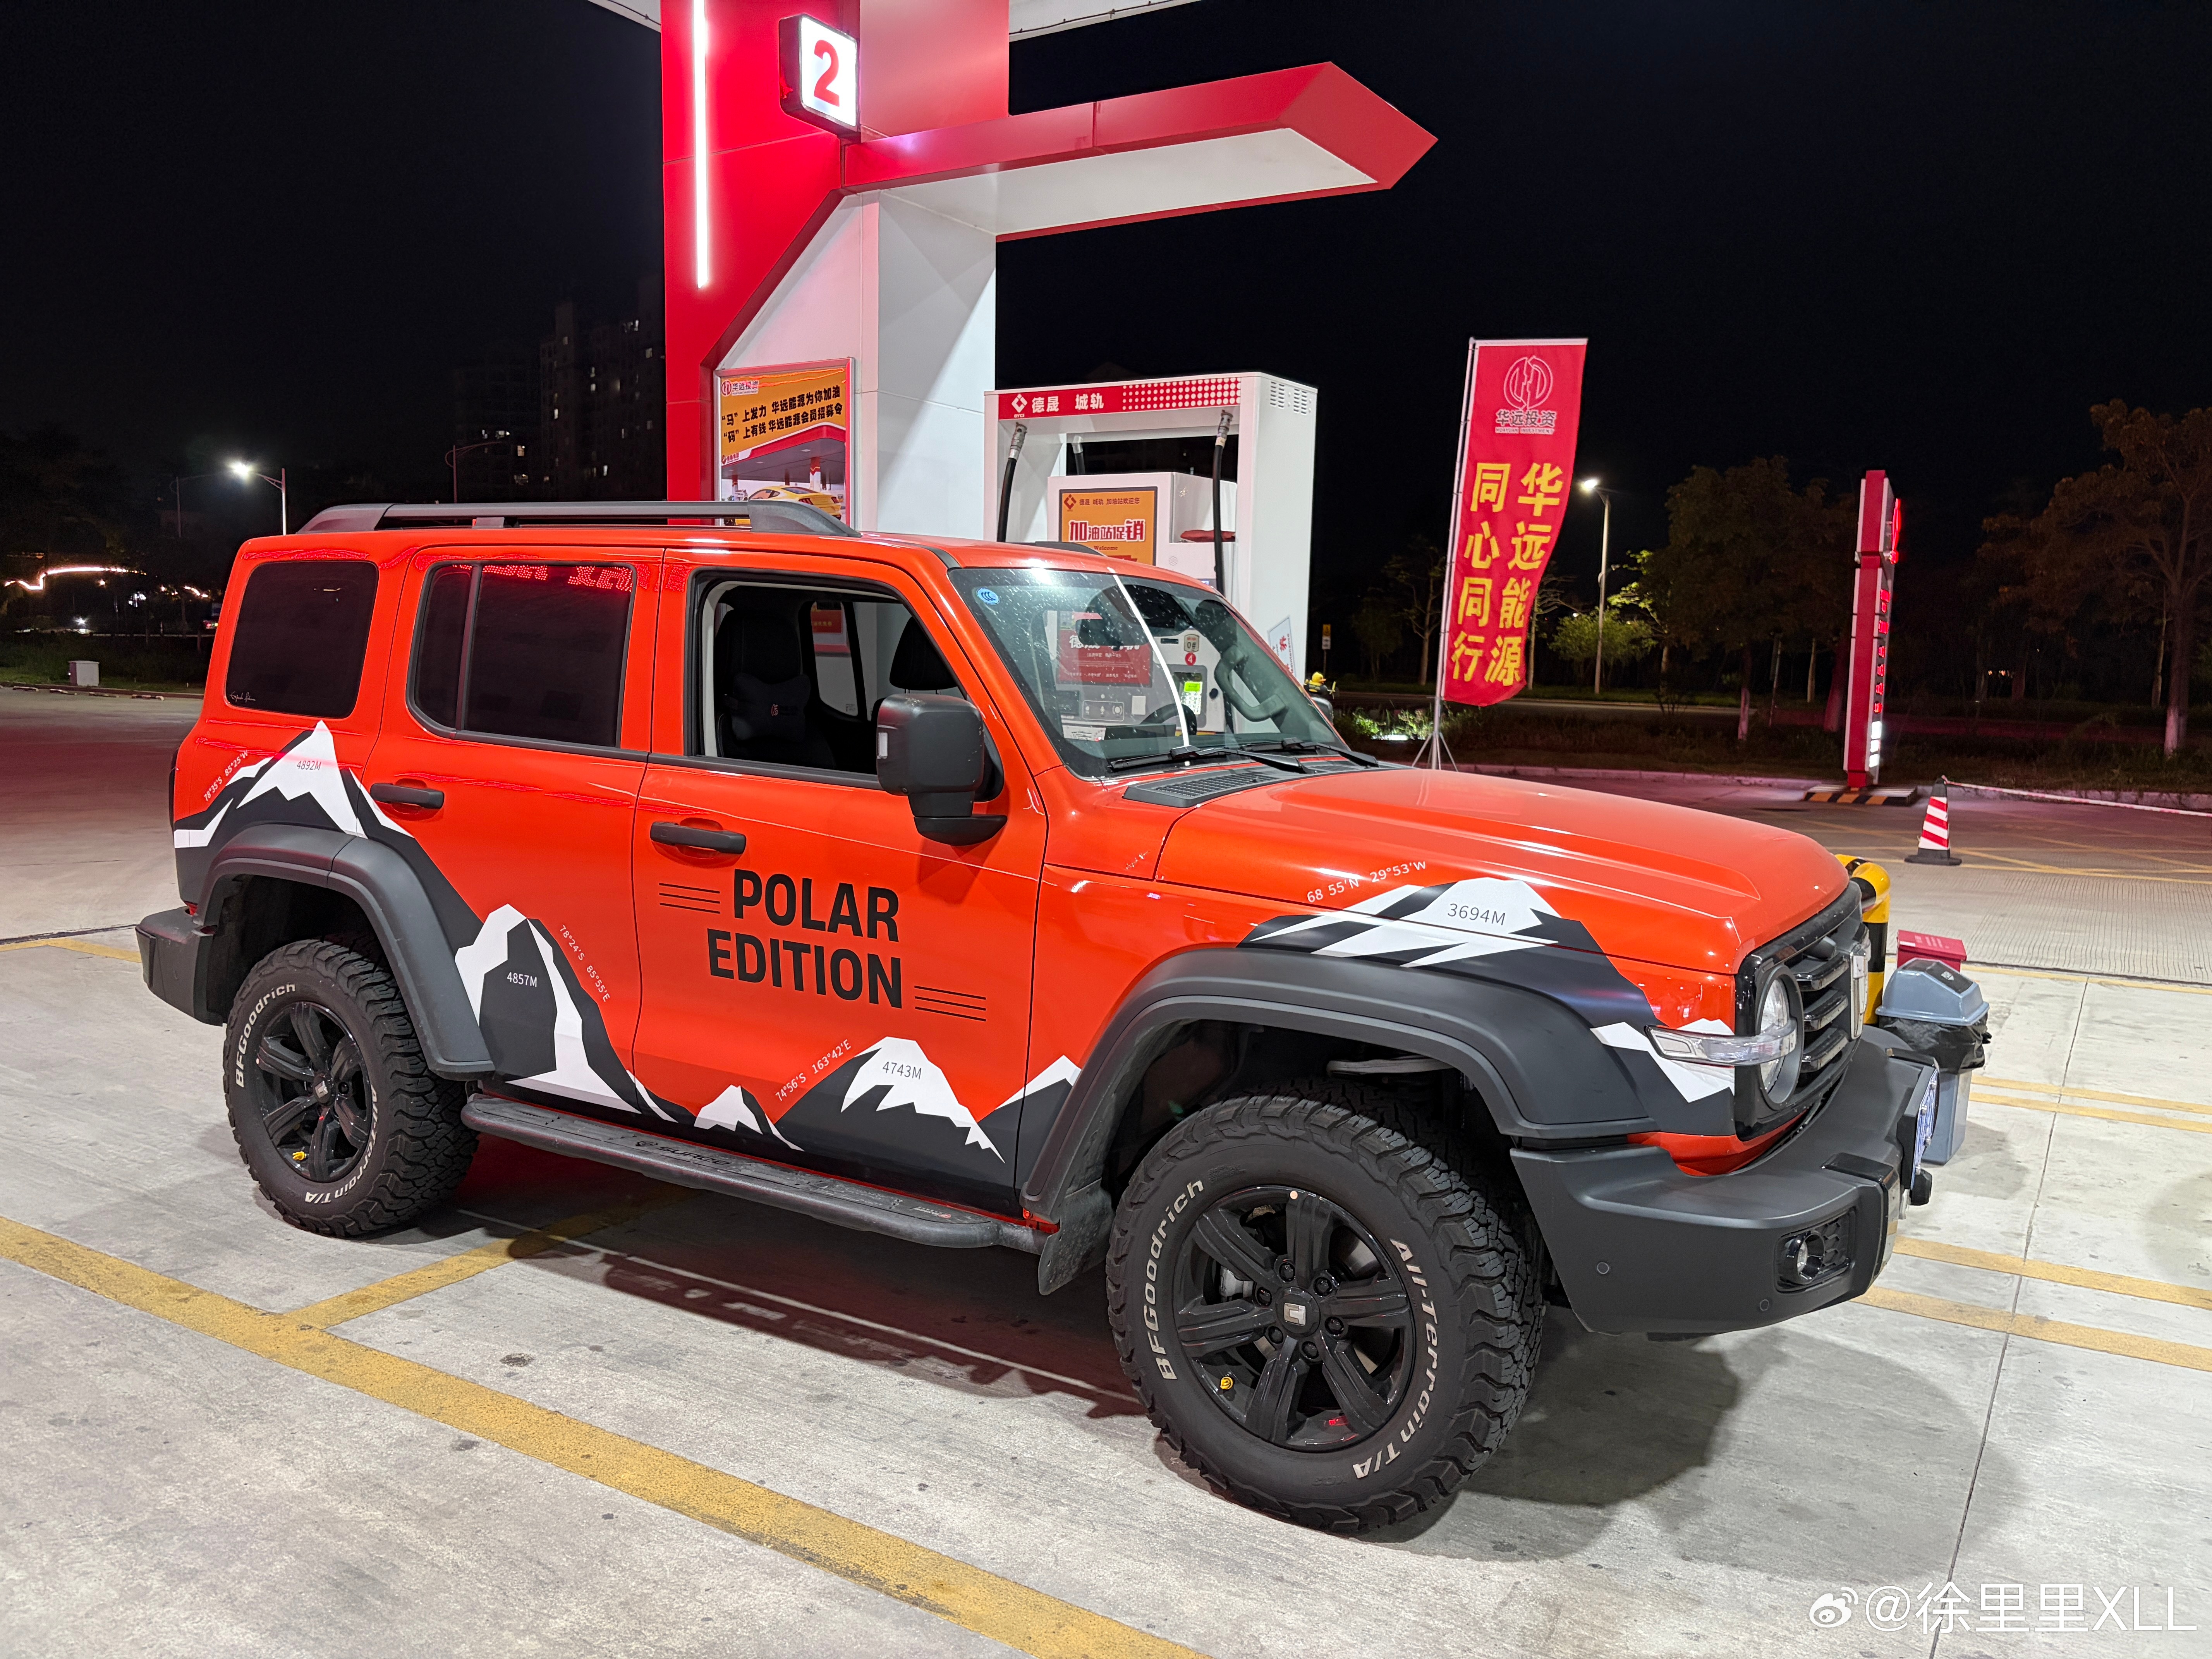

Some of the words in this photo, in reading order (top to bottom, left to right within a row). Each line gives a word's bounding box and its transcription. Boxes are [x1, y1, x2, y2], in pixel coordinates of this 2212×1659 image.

[814, 40, 840, 107] 2
[768, 402, 843, 432] 华远能源会员招募令
[771, 385, 840, 414] 华远能源为你加油
[1031, 395, 1059, 414] 德晟
[1075, 392, 1104, 410] 城轨
[1496, 410, 1556, 426] 华远投资
[1069, 519, 1145, 541] 加油站促销
[1451, 463, 1510, 682] 同心同行
[1485, 463, 1564, 686] 华远能源
[1188, 654, 1193, 663] 4
[296, 761, 322, 771] 4892M
[1307, 888, 1324, 903] 68
[1369, 860, 1426, 883] 29°53'W
[734, 869, 899, 942] POLAR
[1447, 903, 1506, 926] 3694M
[507, 972, 537, 987] 4857M
[560, 924, 585, 961] 78°24'S
[586, 965, 610, 1002] 85°55'E
[707, 928, 902, 1009] EDITION
[235, 982, 296, 1088] BFGoodrich
[775, 1072, 807, 1101] 74°56'S
[811, 1039, 851, 1074] 163°42'E
[883, 1061, 922, 1080] 4743M
[1144, 1180, 1204, 1379] BFGoodrich
[1390, 1239, 1437, 1443] All-Terrain
[1353, 1443, 1400, 1479] T/A
